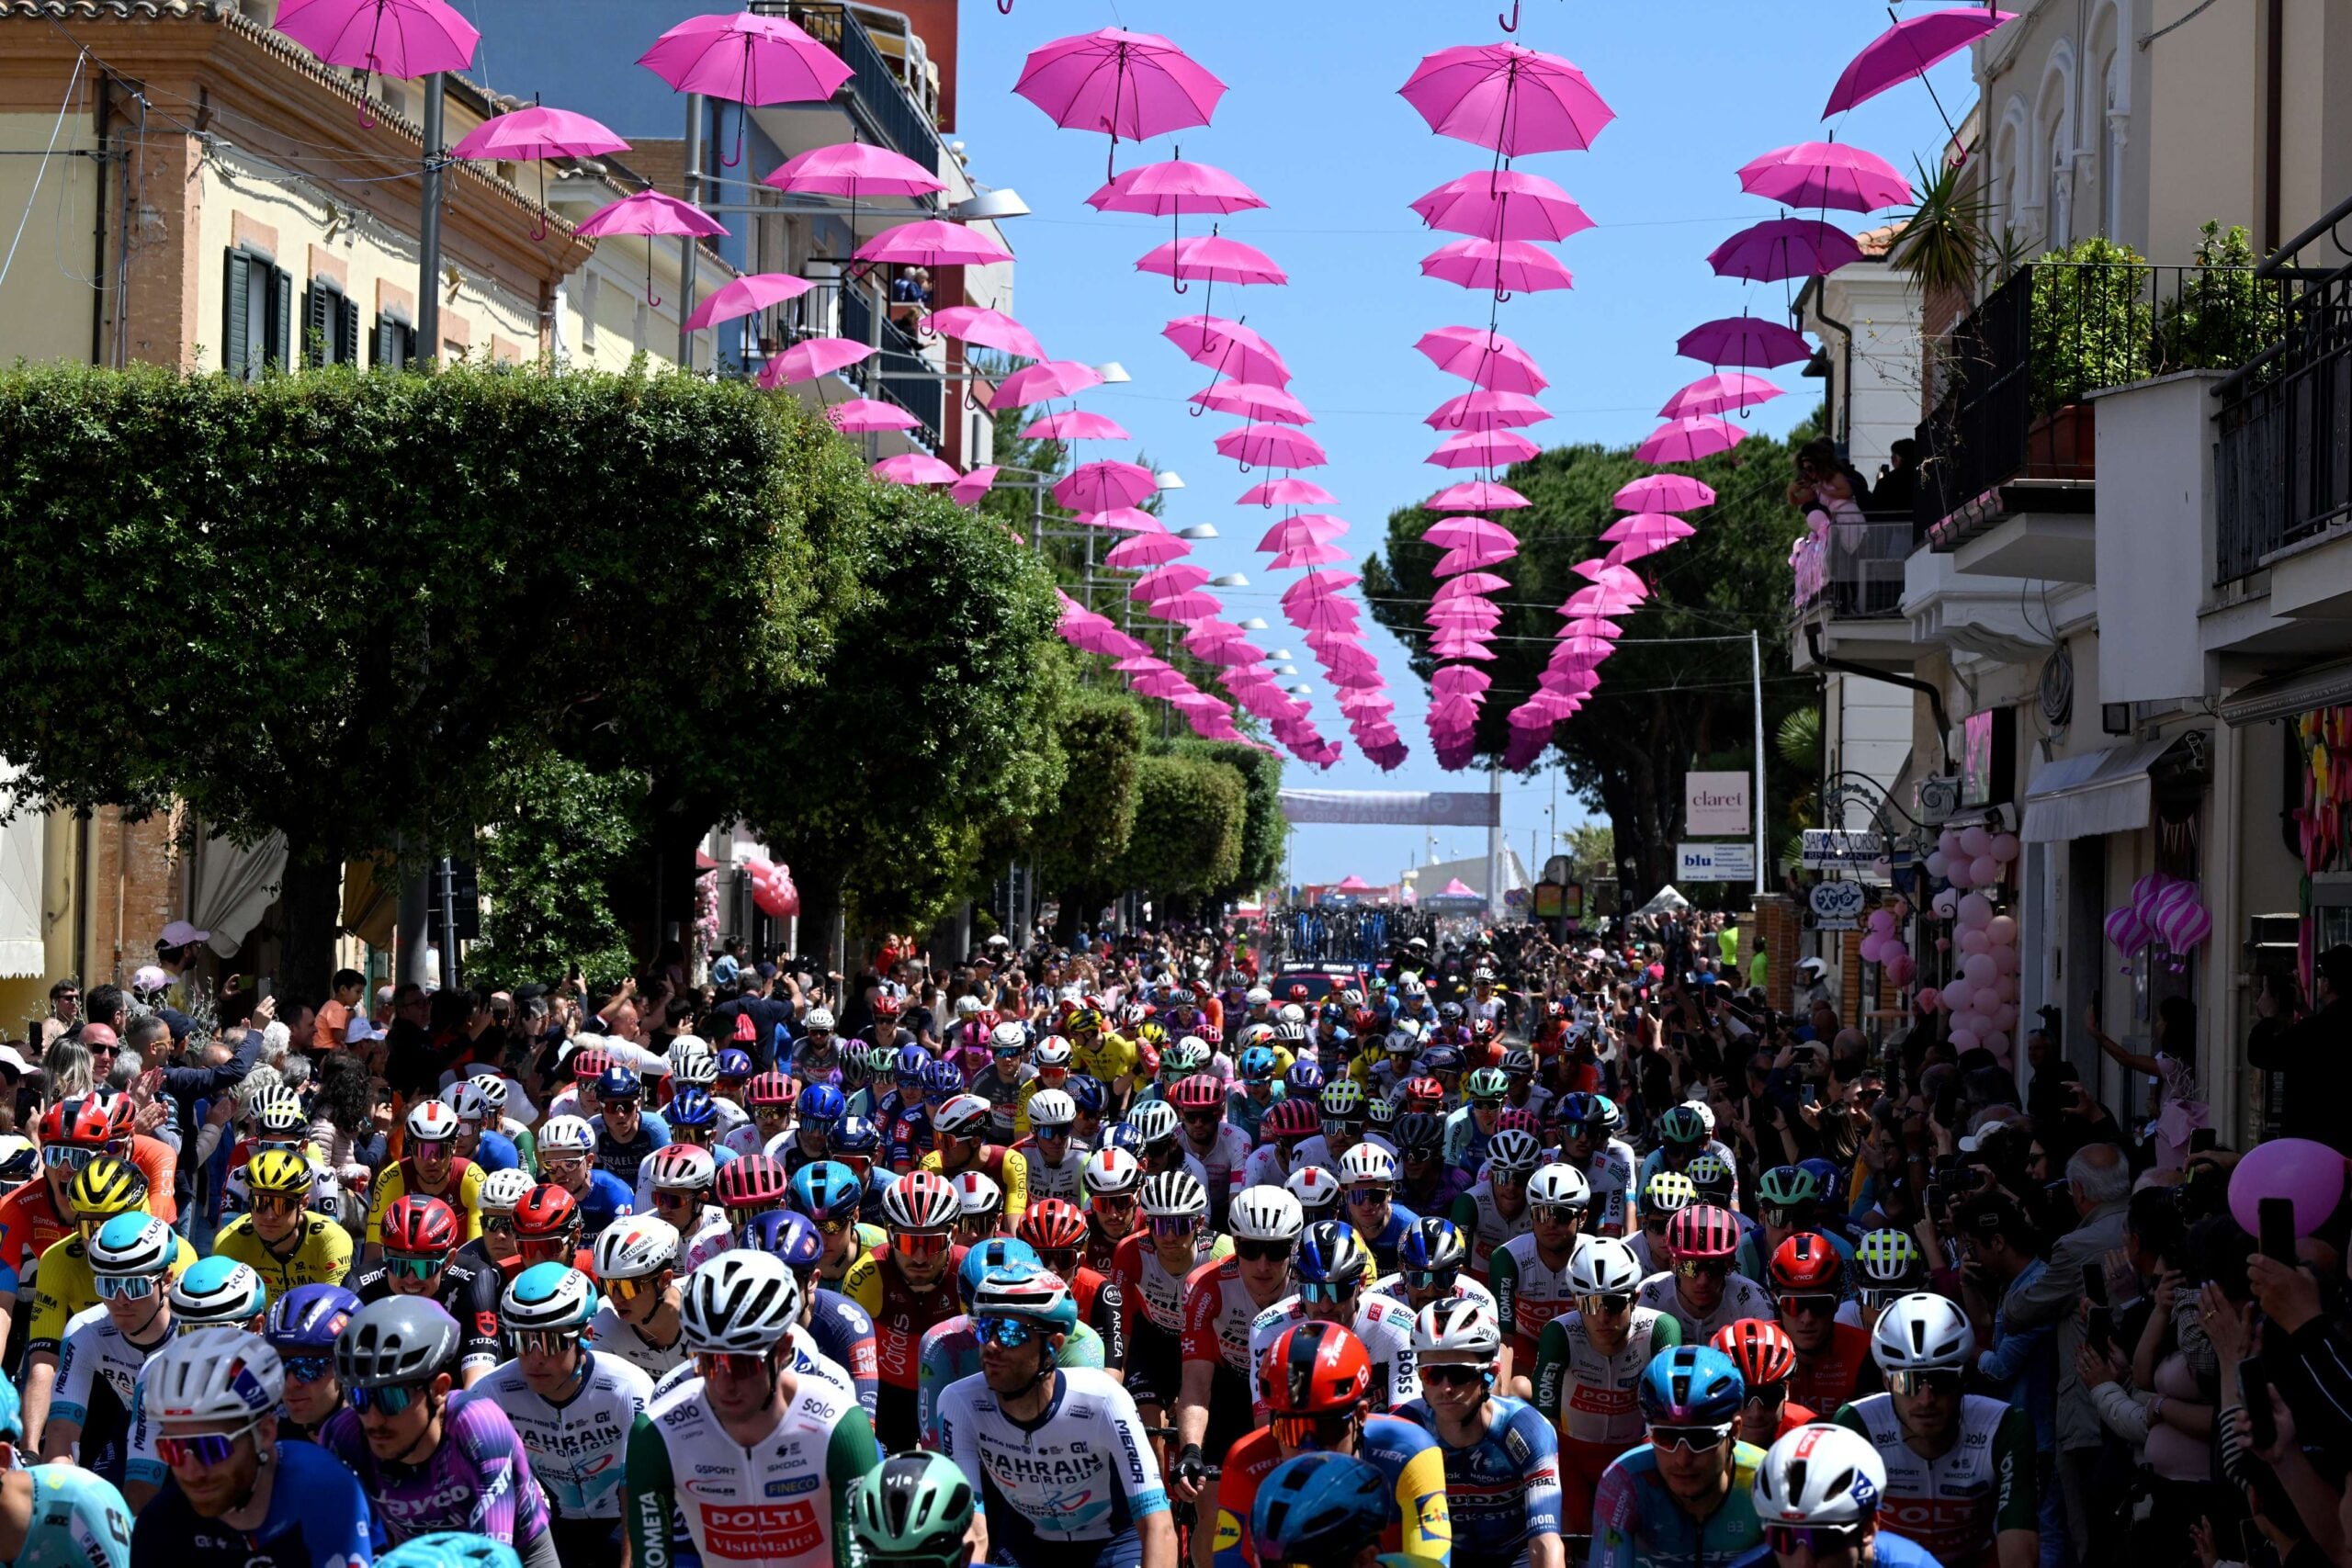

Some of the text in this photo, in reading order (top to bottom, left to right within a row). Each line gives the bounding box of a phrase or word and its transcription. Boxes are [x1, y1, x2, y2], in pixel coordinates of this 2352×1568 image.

[1692, 791, 1743, 807] claret
[1804, 832, 1838, 850] SAPORI
[1848, 833, 1881, 851] CORSO
[1684, 854, 1712, 866] blu
[1807, 851, 1878, 861] RISTORANTE
[17, 1191, 44, 1206] TREK
[370, 1167, 400, 1213] Cofidis
[1610, 1190, 1622, 1217] BOSS
[32, 1215, 59, 1227] Santini
[359, 1267, 387, 1290] BMC
[447, 1266, 477, 1282] BMC
[1466, 1291, 1490, 1306] BORA
[1498, 1278, 1512, 1323] KOMETA
[1193, 1292, 1213, 1331] TECHNORD
[1251, 1308, 1280, 1327] BORA
[878, 1314, 910, 1375] Cofidis
[1112, 1310, 1124, 1359] ARKEA
[55, 1343, 76, 1394] MERIDA
[1396, 1349, 1414, 1394] BOSS
[653, 1374, 684, 1400] BORA
[1538, 1361, 1561, 1407] KOMETA
[663, 1404, 700, 1427] solo
[802, 1397, 836, 1419] solo
[981, 1447, 1102, 1476] BAHRAIN
[1114, 1419, 1146, 1484] MERIDA
[1371, 1447, 1408, 1463] TREK
[768, 1478, 819, 1495] FINECO
[371, 1485, 470, 1517] Jayco
[639, 1490, 668, 1568] OMETA
[712, 1509, 803, 1528] POLTI
[1726, 1520, 1745, 1533] 83
